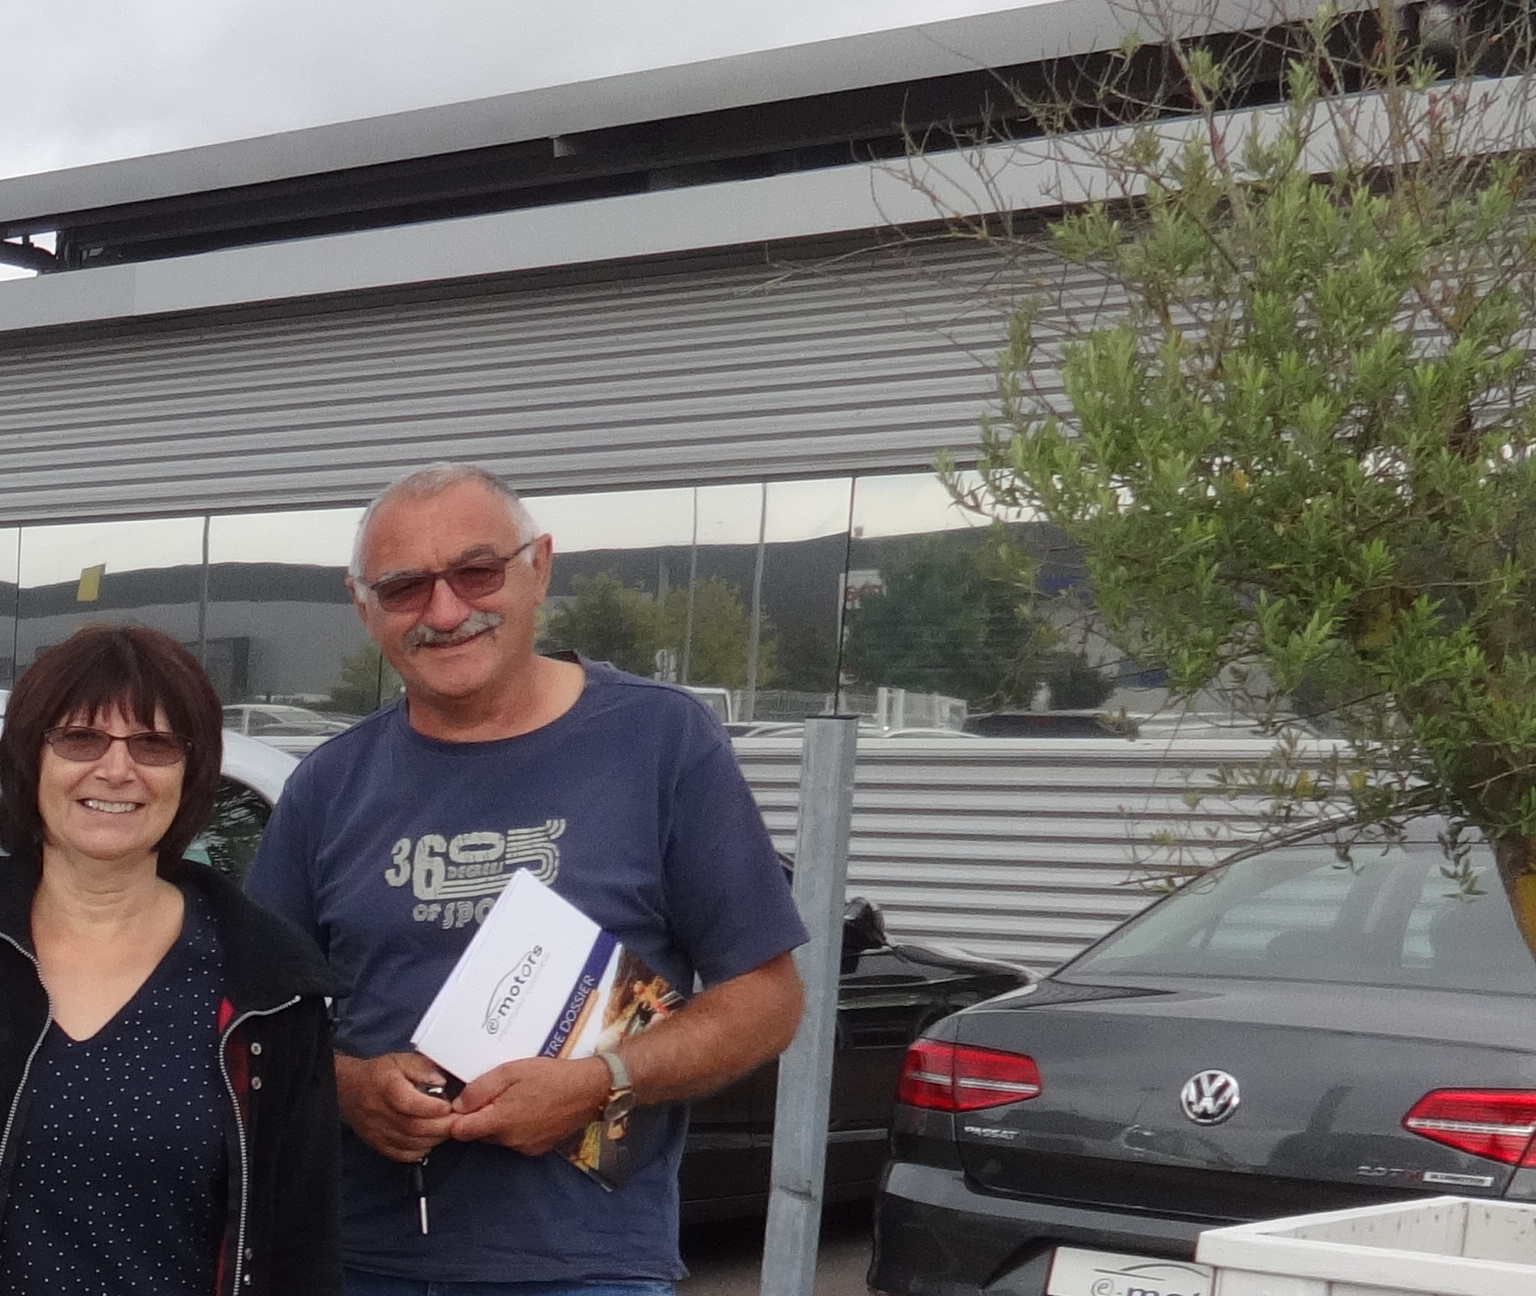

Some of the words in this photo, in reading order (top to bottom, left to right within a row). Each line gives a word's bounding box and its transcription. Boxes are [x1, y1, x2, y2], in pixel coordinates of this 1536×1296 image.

[442, 897, 495, 930] SPO
[543, 1030, 566, 1058] TRE
[559, 974, 596, 1033] DOSSIER
